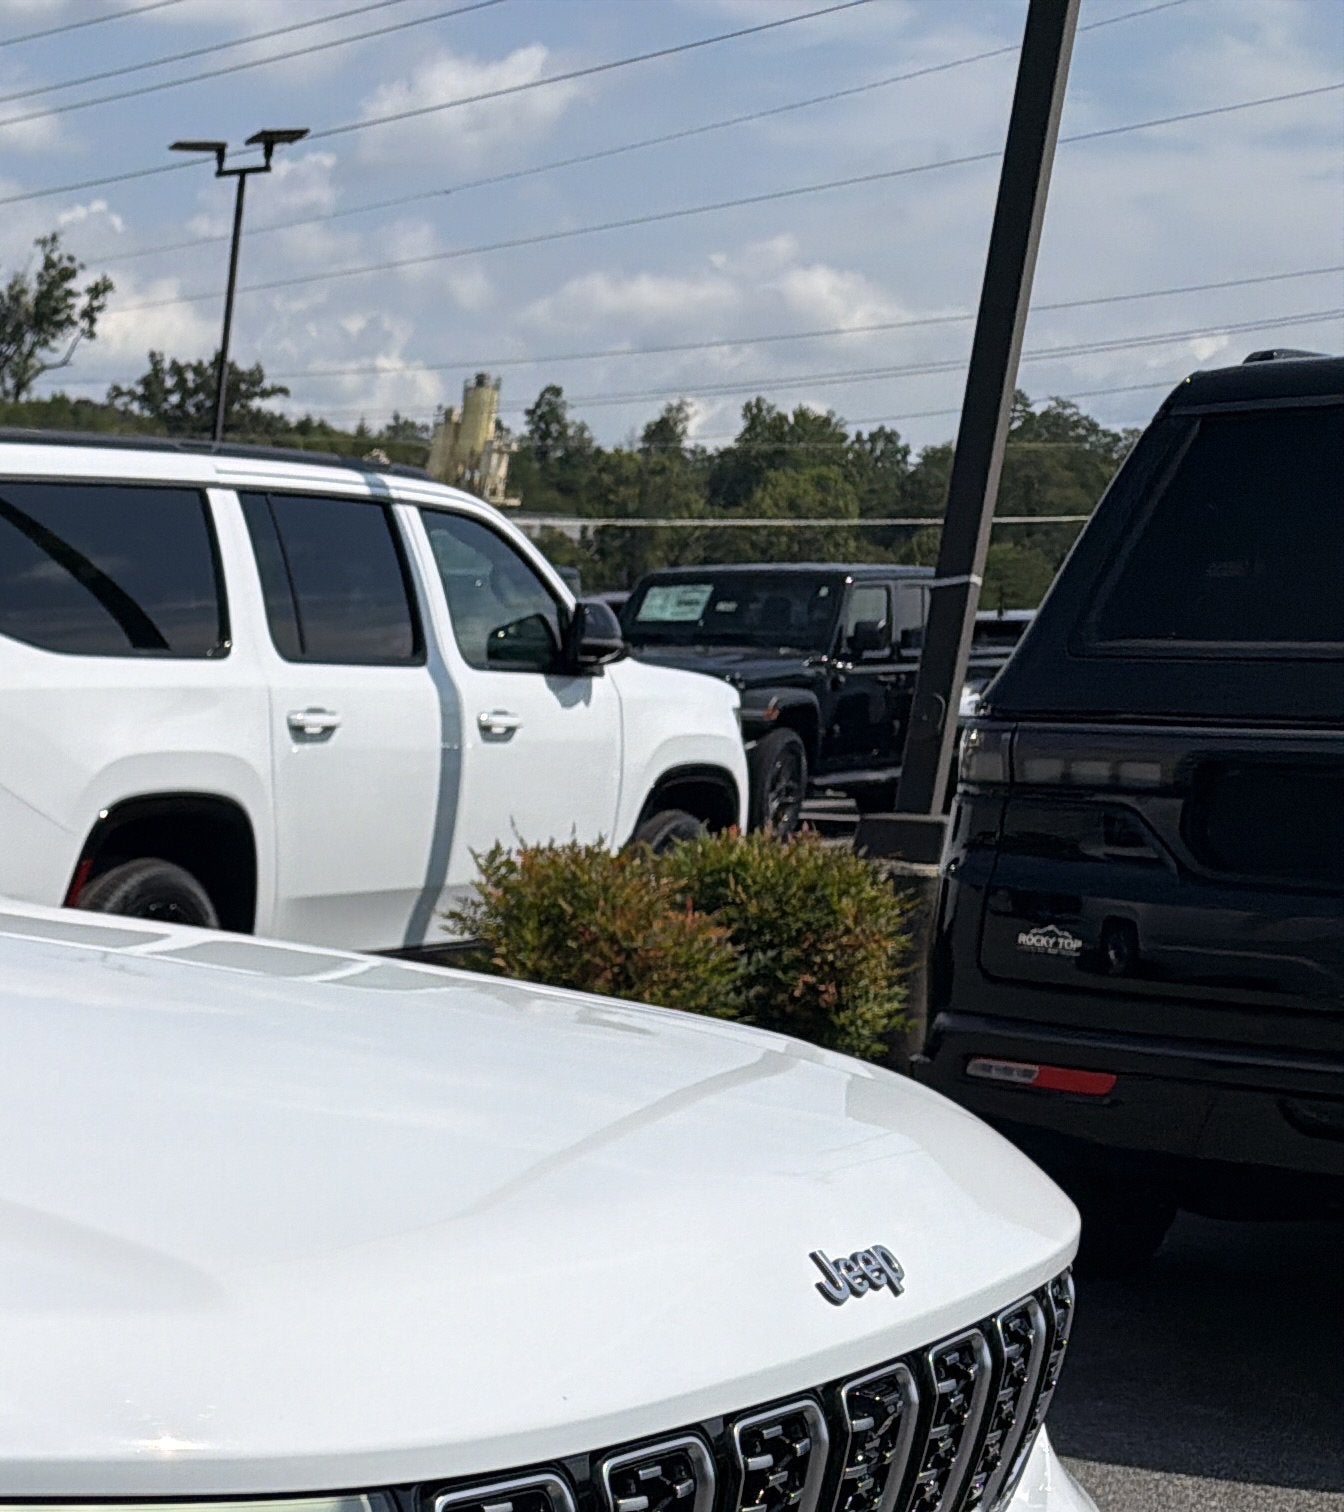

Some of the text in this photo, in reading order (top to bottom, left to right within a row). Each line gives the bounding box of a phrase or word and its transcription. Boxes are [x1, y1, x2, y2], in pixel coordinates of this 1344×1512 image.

[1017, 932, 1057, 948] ROCKY
[1057, 937, 1083, 951] TOP
[808, 1244, 905, 1307] Jeep
